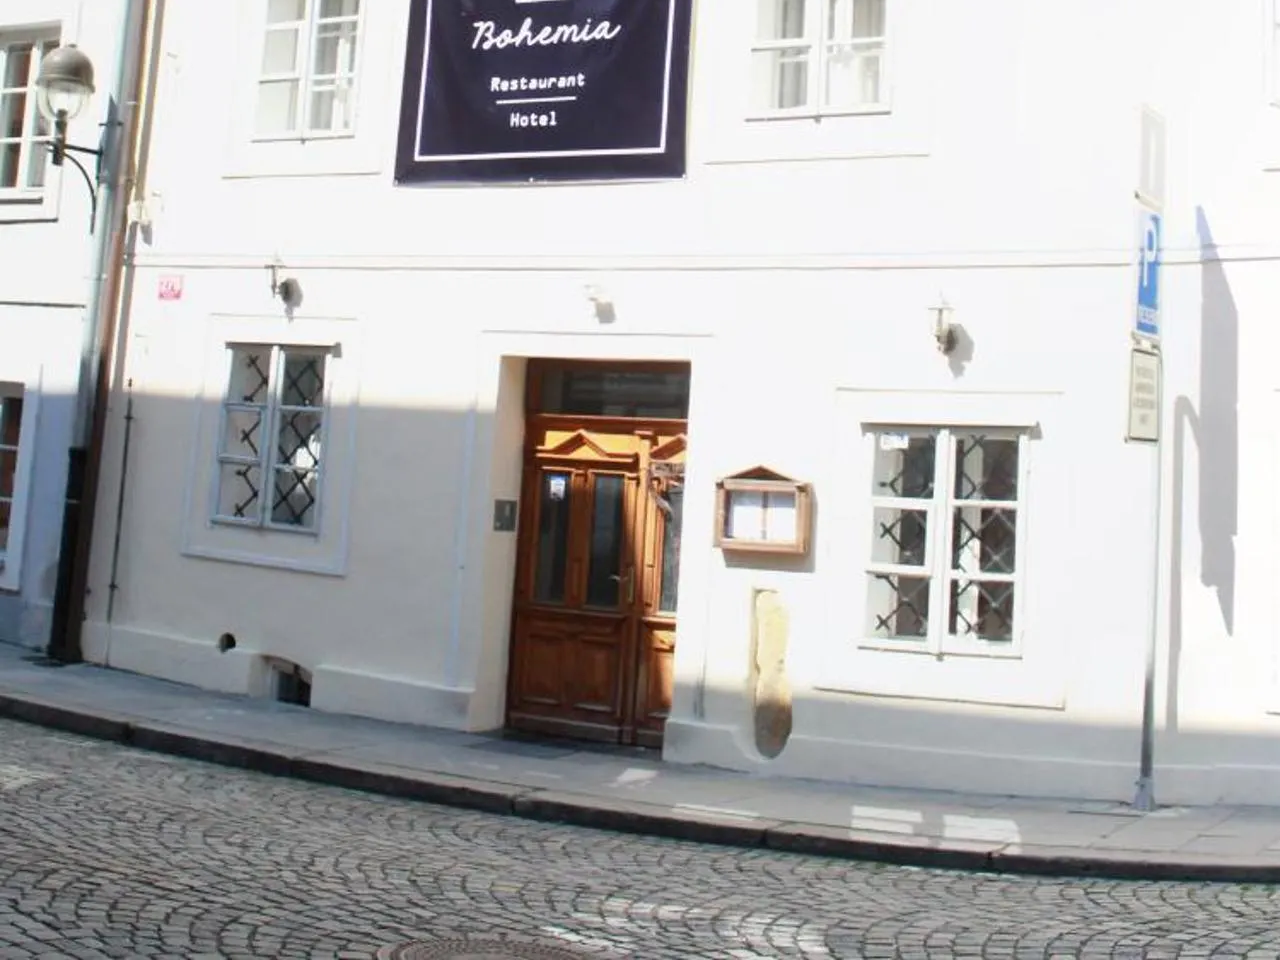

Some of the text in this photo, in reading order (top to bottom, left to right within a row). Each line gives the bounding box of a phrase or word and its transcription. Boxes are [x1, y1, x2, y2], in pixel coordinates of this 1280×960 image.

[472, 17, 621, 50] Bohemia
[491, 73, 584, 91] Restaurant
[510, 111, 556, 127] Hotel
